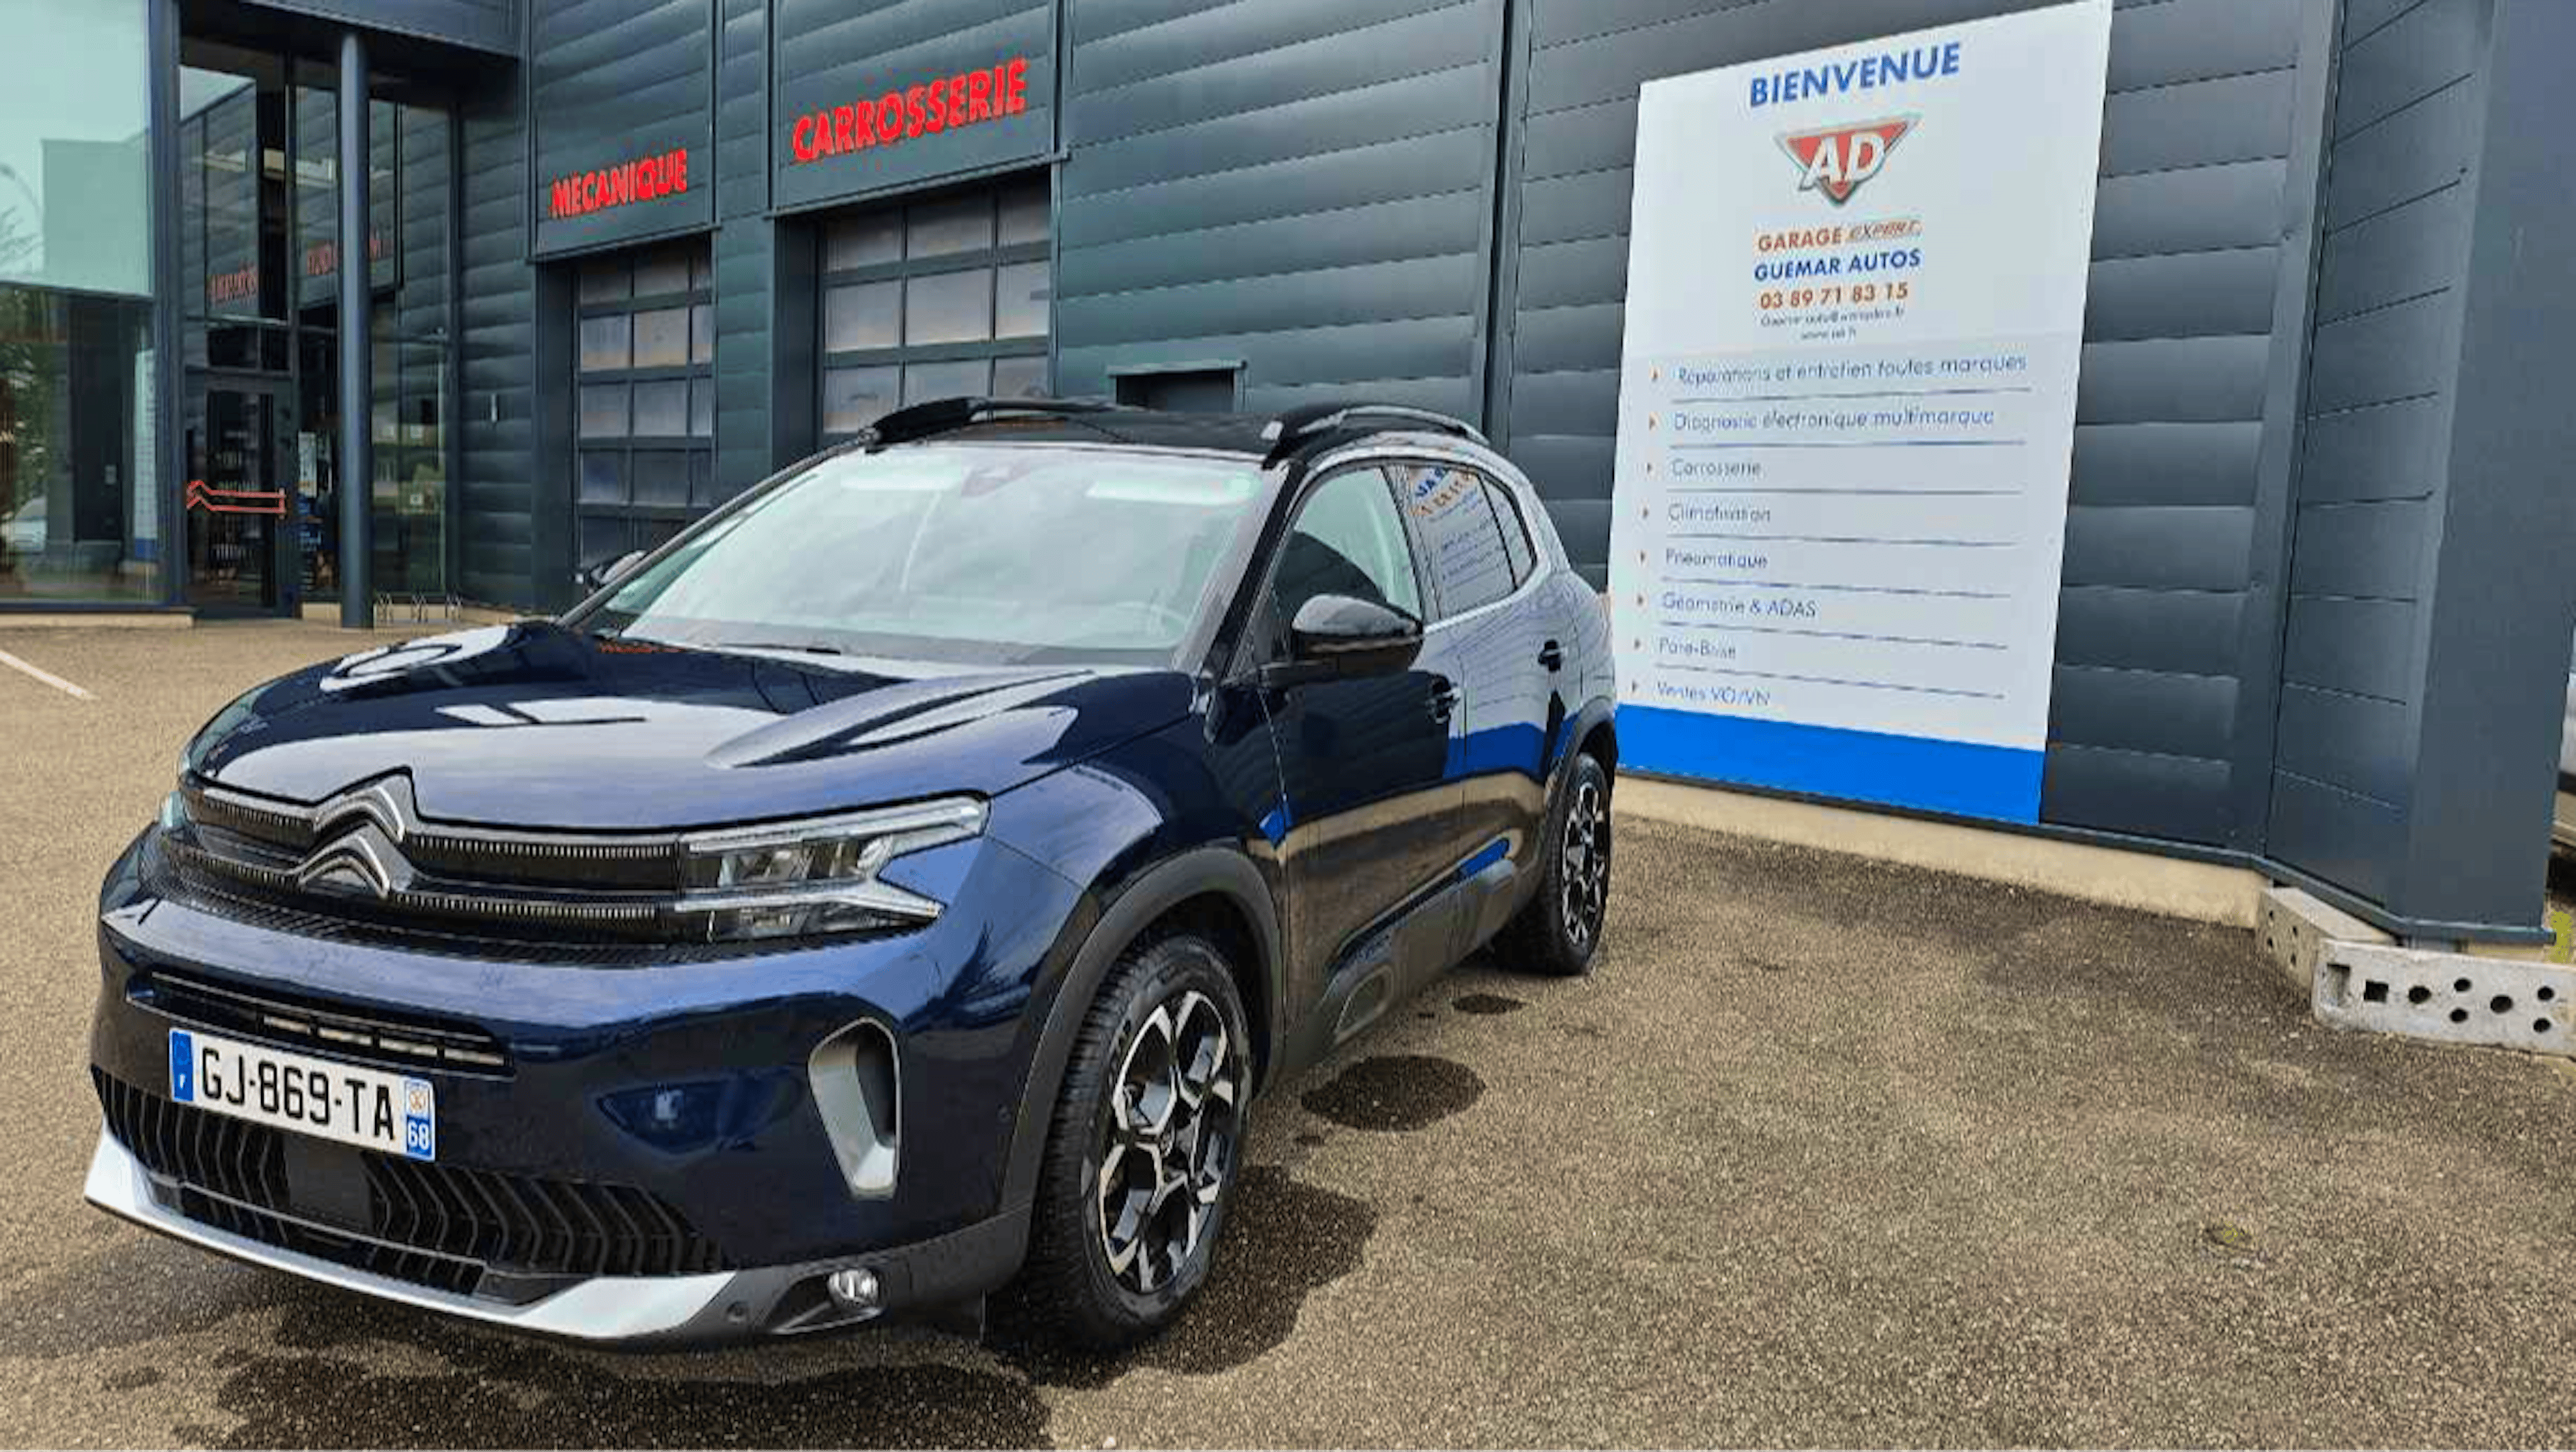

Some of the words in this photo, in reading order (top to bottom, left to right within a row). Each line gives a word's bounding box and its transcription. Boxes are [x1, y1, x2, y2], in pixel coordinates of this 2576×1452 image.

[1751, 42, 1960, 107] BIENVENUE
[792, 55, 1028, 163] CARROSSERIE
[1798, 132, 1886, 193] AD
[1758, 227, 1842, 252] GARAGE
[1754, 256, 1840, 281] GUEMAR
[1848, 248, 1921, 273] AUTOS
[1760, 291, 1783, 309] 03
[1790, 289, 1813, 308] 89
[1821, 285, 1841, 305] 71
[1852, 283, 1876, 303] 83
[1886, 280, 1909, 301] 15
[1877, 358, 1935, 378] toutes
[1941, 354, 2027, 376] marques
[1763, 407, 1867, 430] électronique
[1670, 458, 1762, 478] Carrosserie
[1666, 548, 1768, 570] Pneumatique
[1750, 599, 1761, 615] &
[1767, 599, 1816, 618] ADAS
[202, 1047, 395, 1141] GJ-869-TA
[407, 1120, 430, 1150] 68
